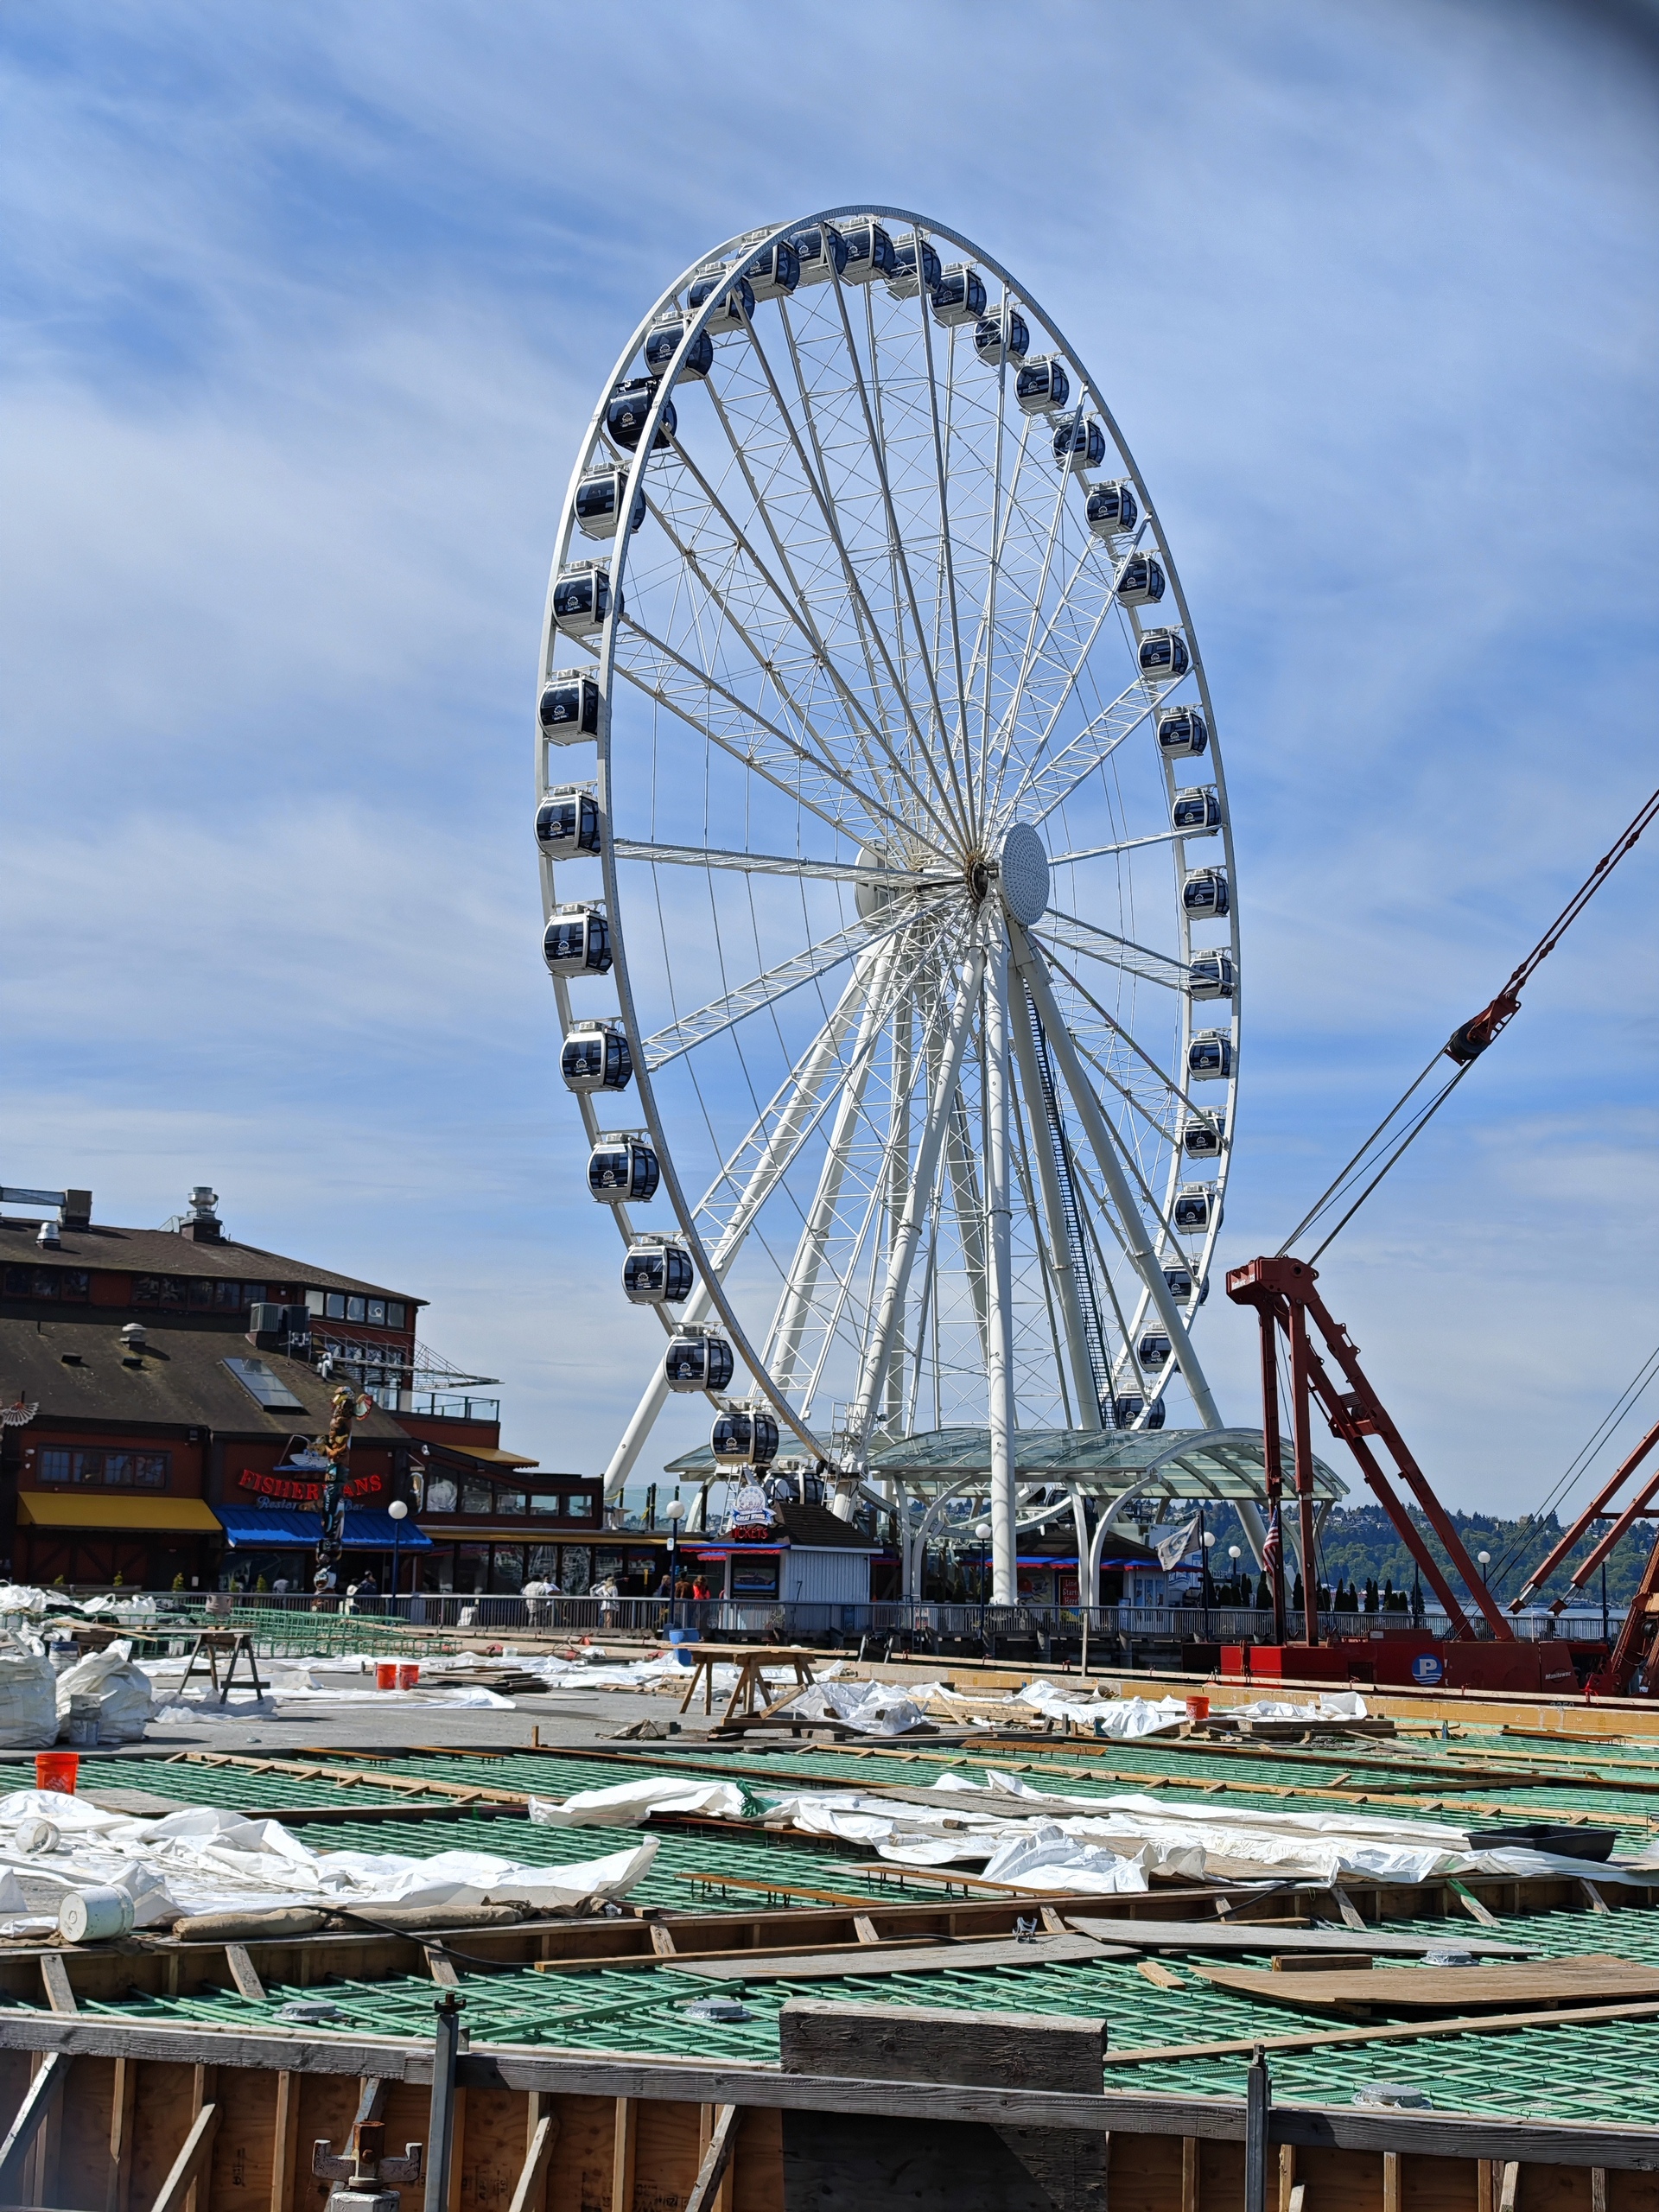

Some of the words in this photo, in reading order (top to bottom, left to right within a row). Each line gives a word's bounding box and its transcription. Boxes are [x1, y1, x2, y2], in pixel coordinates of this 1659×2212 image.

[238, 1469, 382, 1500] FISHERANS
[731, 1525, 769, 1539] TICKETS
[1419, 1658, 1438, 1676] P
[1545, 1671, 1572, 1680] Manitowoc
